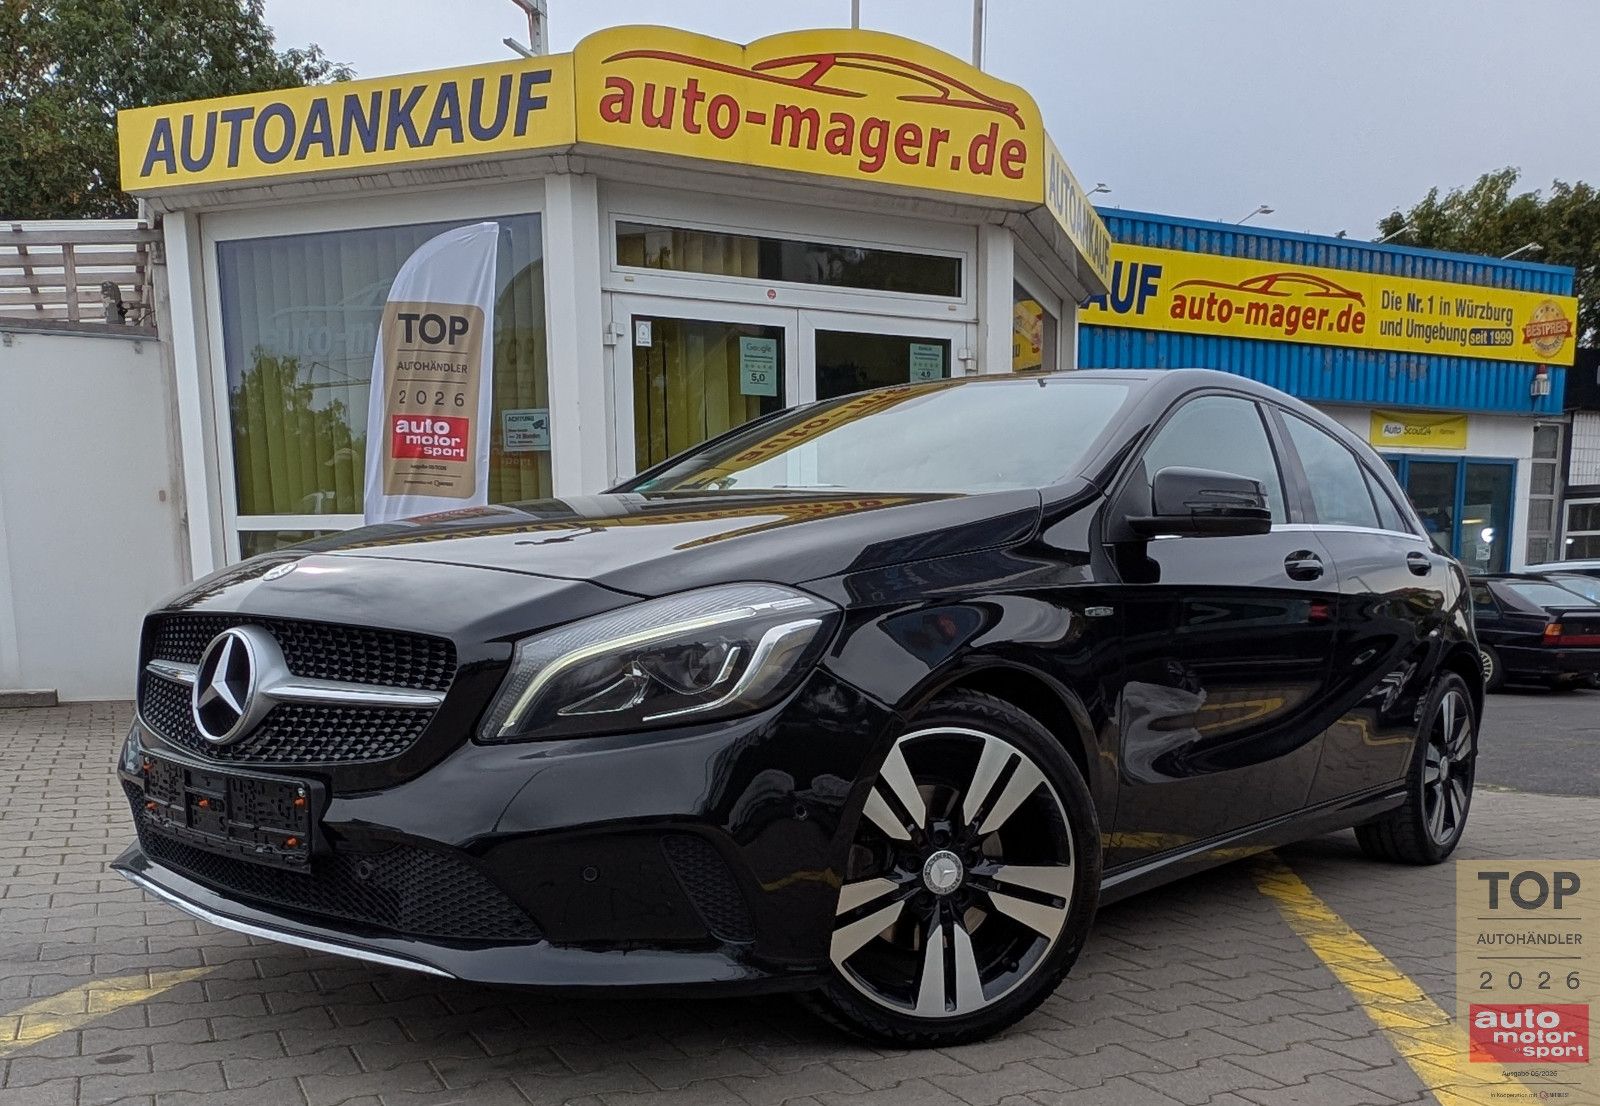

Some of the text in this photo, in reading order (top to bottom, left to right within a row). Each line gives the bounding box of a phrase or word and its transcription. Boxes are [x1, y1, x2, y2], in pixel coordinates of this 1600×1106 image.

[140, 70, 552, 177] AUTOANKAUF
[599, 77, 1027, 179] auto-mager.de
[1049, 152, 1110, 279] AUTOANKAUF
[1170, 292, 1366, 336] auto-mager.de
[1381, 290, 1513, 327] Die Nr. 1 in Würzburg
[397, 313, 469, 346] TOP
[1380, 318, 1512, 347] und Umgebung seit 1999
[396, 360, 468, 374] AUTOHÄNDLER
[751, 373, 766, 382] 5,0
[398, 389, 465, 407] 2026
[395, 418, 450, 435] auto
[406, 434, 461, 447] motor
[423, 446, 465, 458] sport
